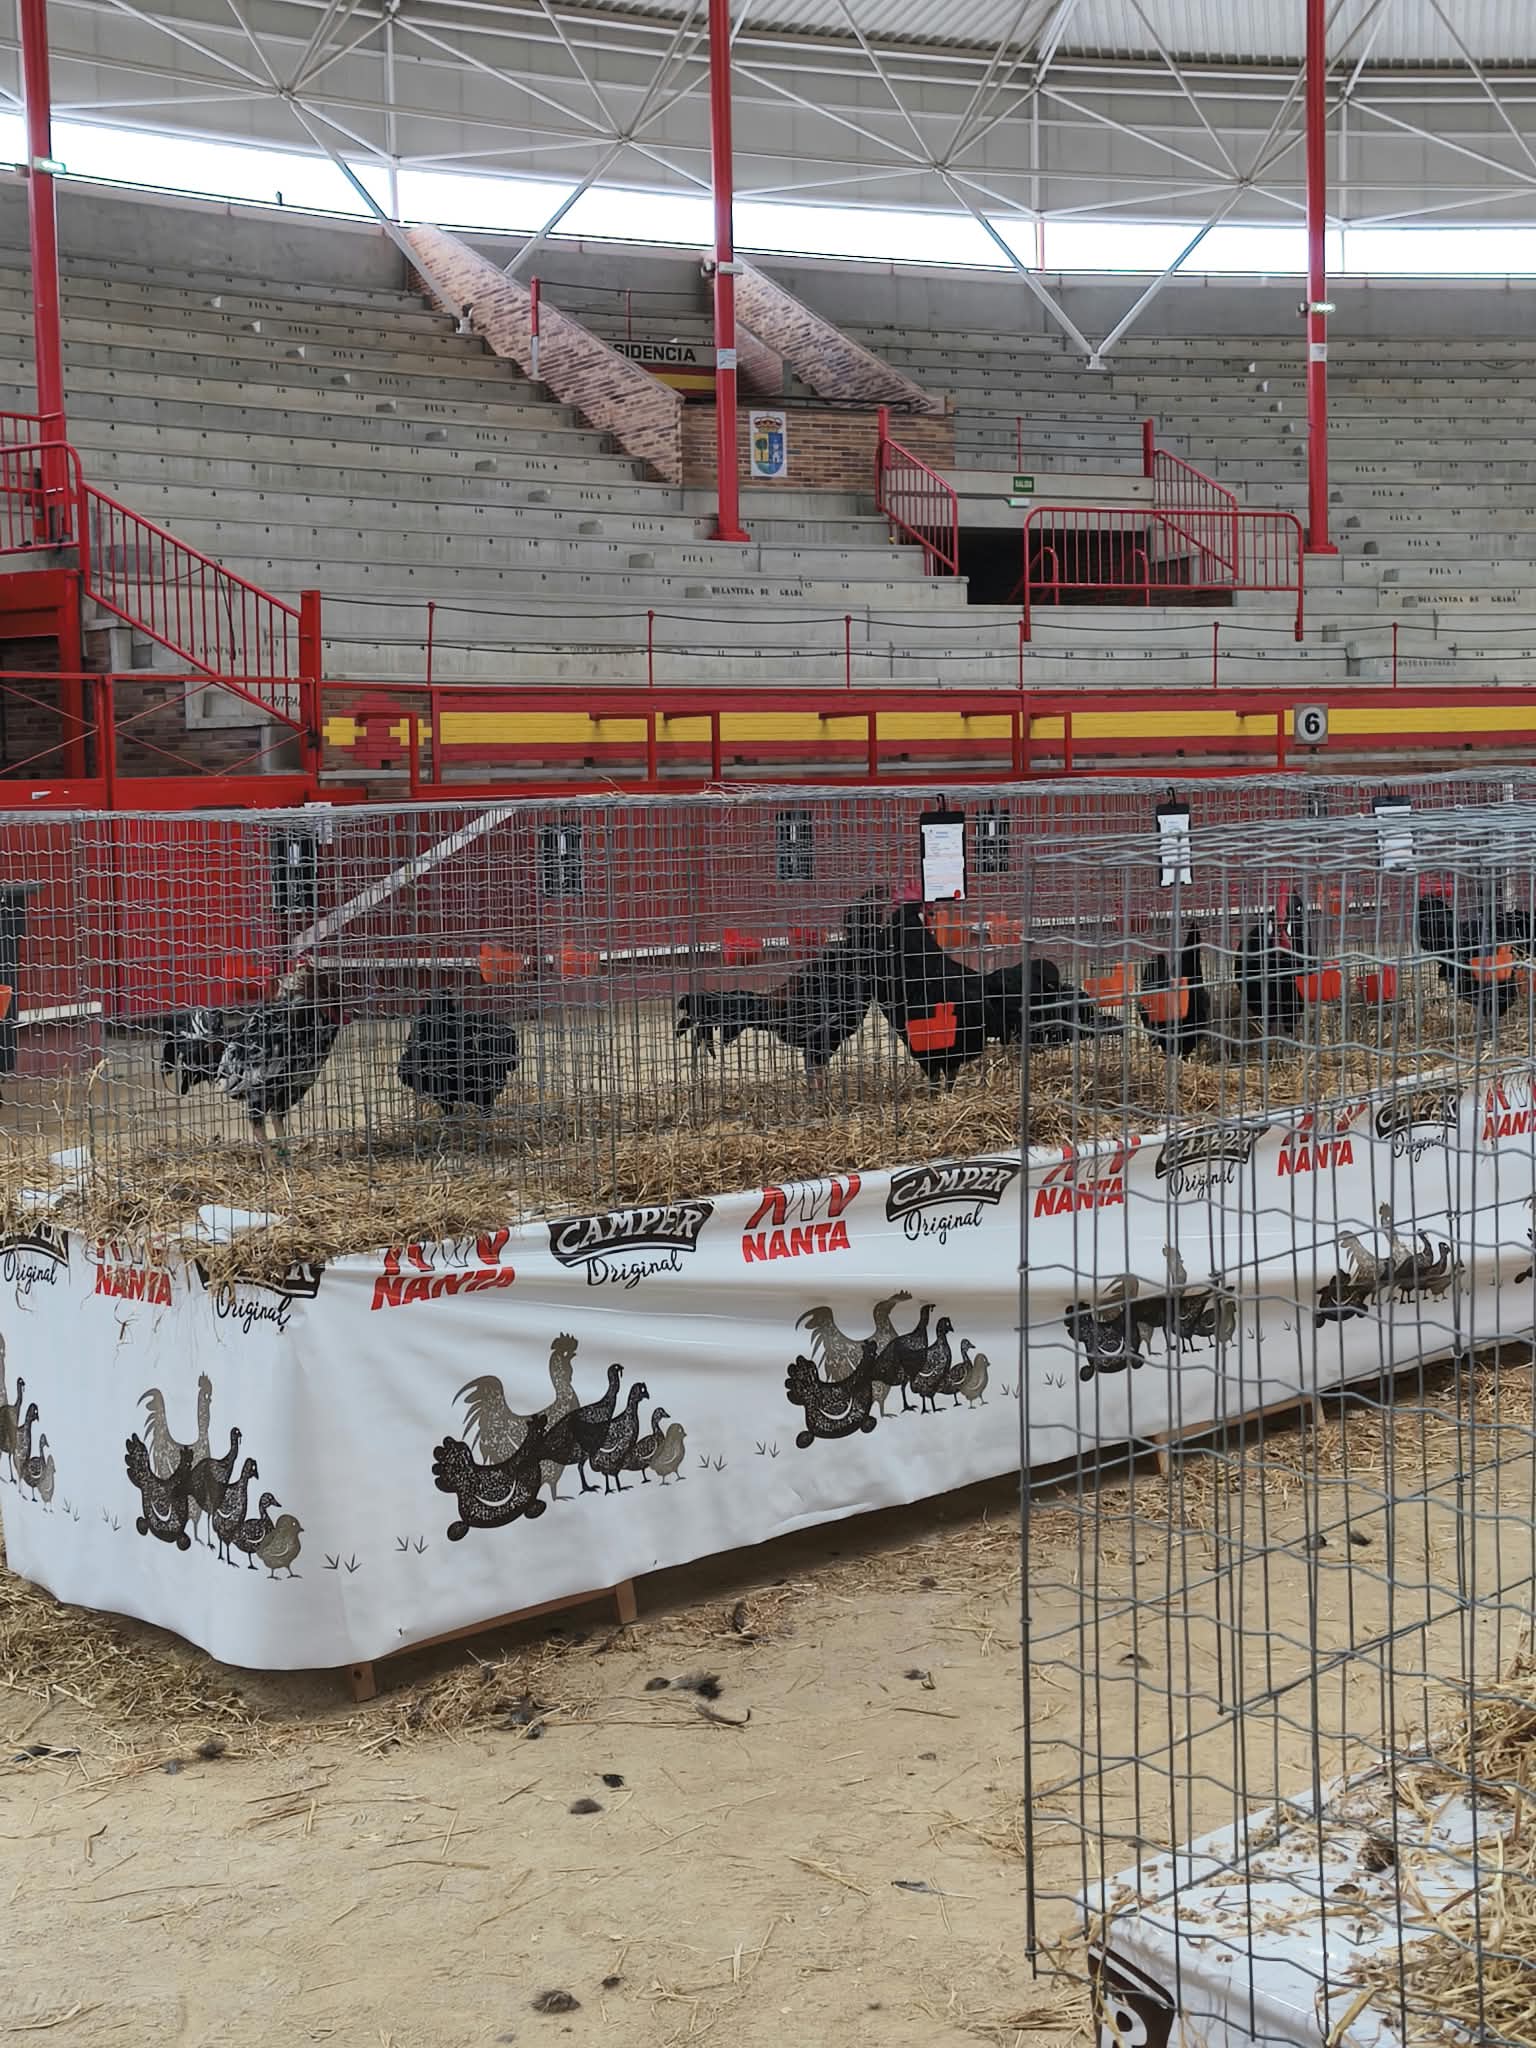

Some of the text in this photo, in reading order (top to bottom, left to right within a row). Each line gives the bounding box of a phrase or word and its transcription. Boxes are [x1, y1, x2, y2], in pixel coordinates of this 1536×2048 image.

[610, 343, 696, 362] SIDENCIA
[1304, 712, 1320, 735] 6
[1277, 1140, 1354, 1176] NANTA
[893, 1166, 1010, 1206] CAMPER
[1034, 1177, 1124, 1218] NANTA
[556, 1204, 702, 1254] CAMPER
[742, 1220, 850, 1263] NANTA
[904, 1202, 983, 1245] Original
[4, 1249, 58, 1295] Original
[95, 1264, 172, 1306] NANTA
[587, 1250, 684, 1289] Original
[216, 1283, 292, 1334] Original
